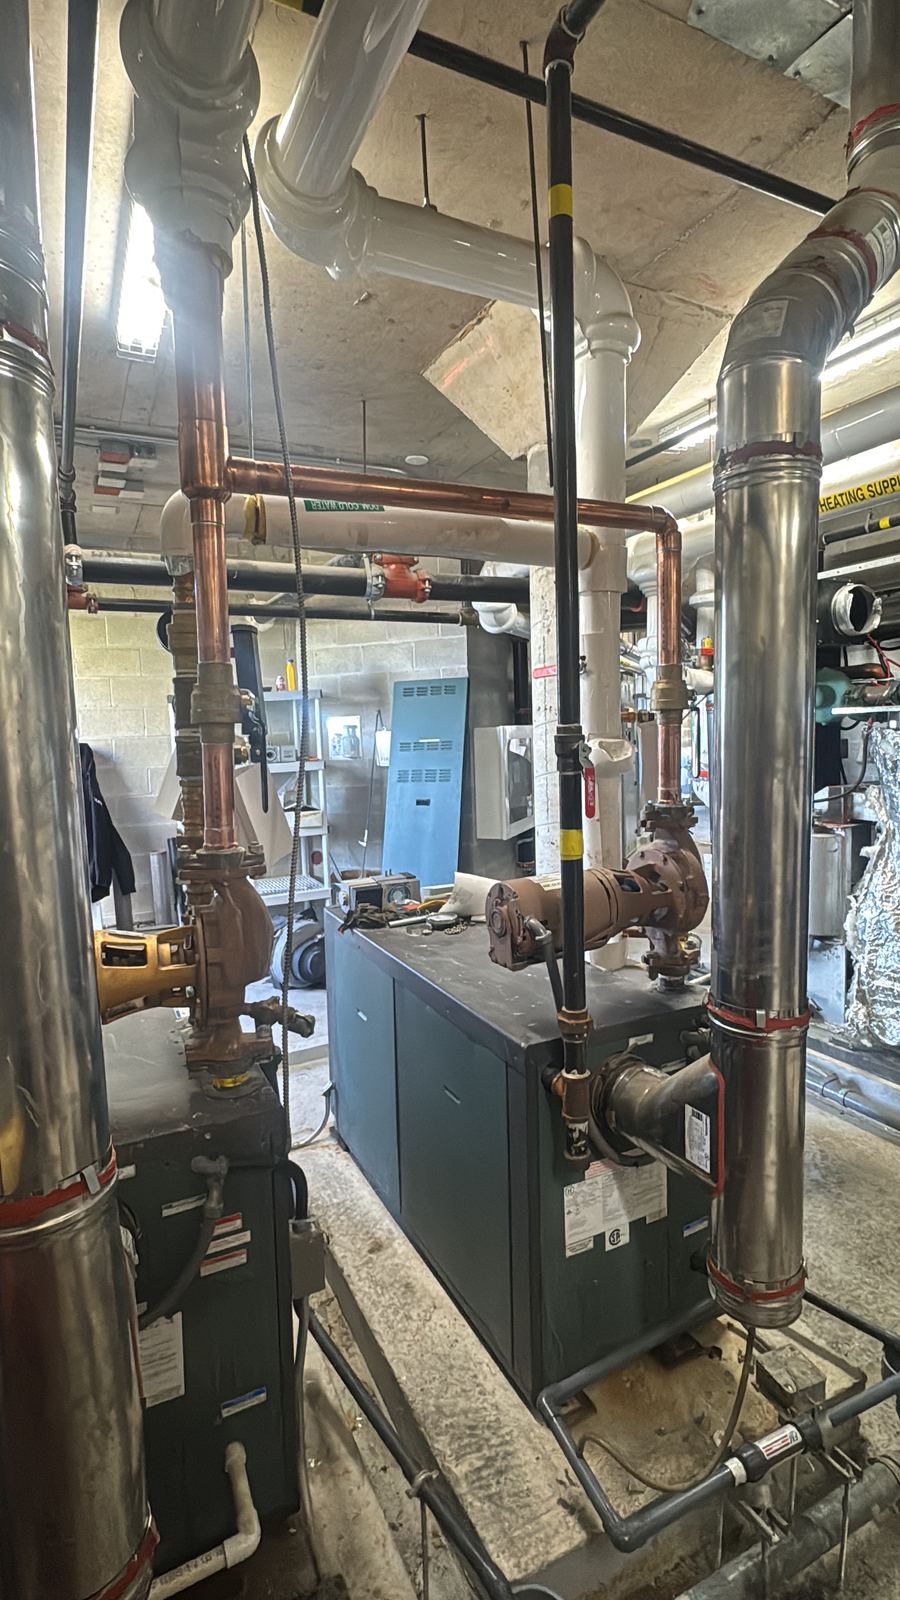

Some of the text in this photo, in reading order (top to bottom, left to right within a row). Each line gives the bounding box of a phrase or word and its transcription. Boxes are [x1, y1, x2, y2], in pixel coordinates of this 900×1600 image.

[311, 499, 337, 510] WATER
[819, 487, 866, 512] HEATING
[339, 501, 359, 510] COLD
